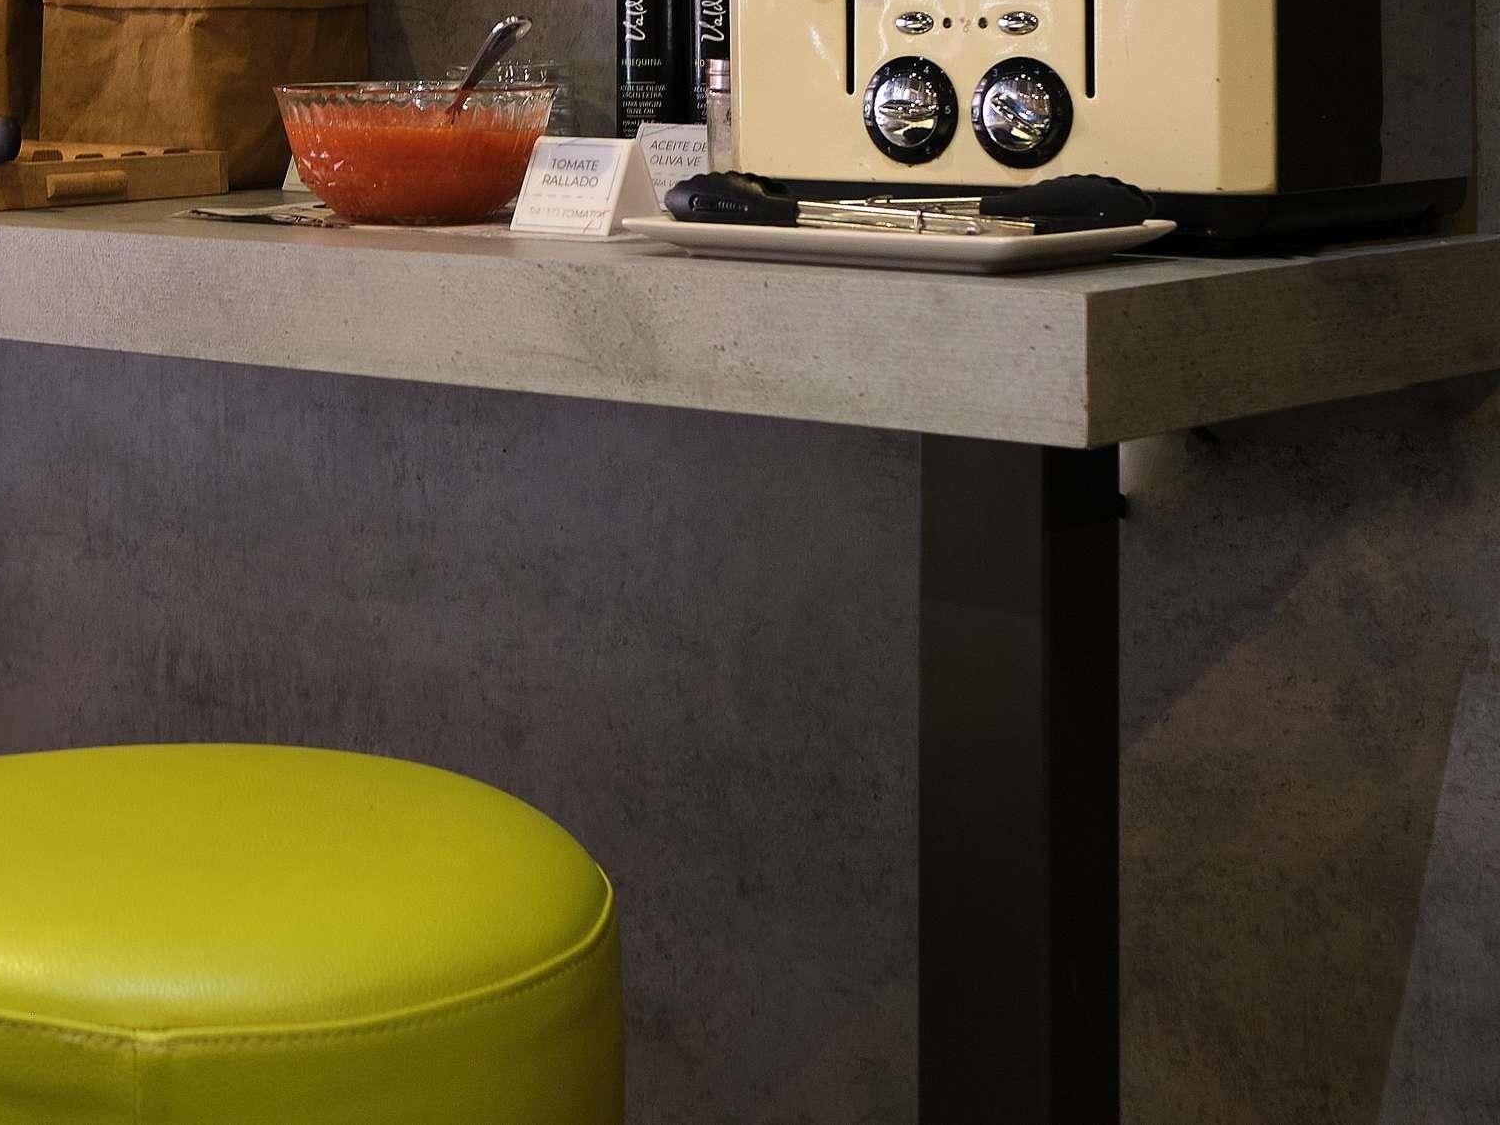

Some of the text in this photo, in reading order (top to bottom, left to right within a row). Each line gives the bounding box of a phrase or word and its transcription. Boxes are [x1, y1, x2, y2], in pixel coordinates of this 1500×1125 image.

[650, 140, 707, 152] ACEITE DE
[551, 158, 599, 172] TOMATE
[649, 156, 684, 168] OLIVA
[542, 174, 599, 187] RALLADO
